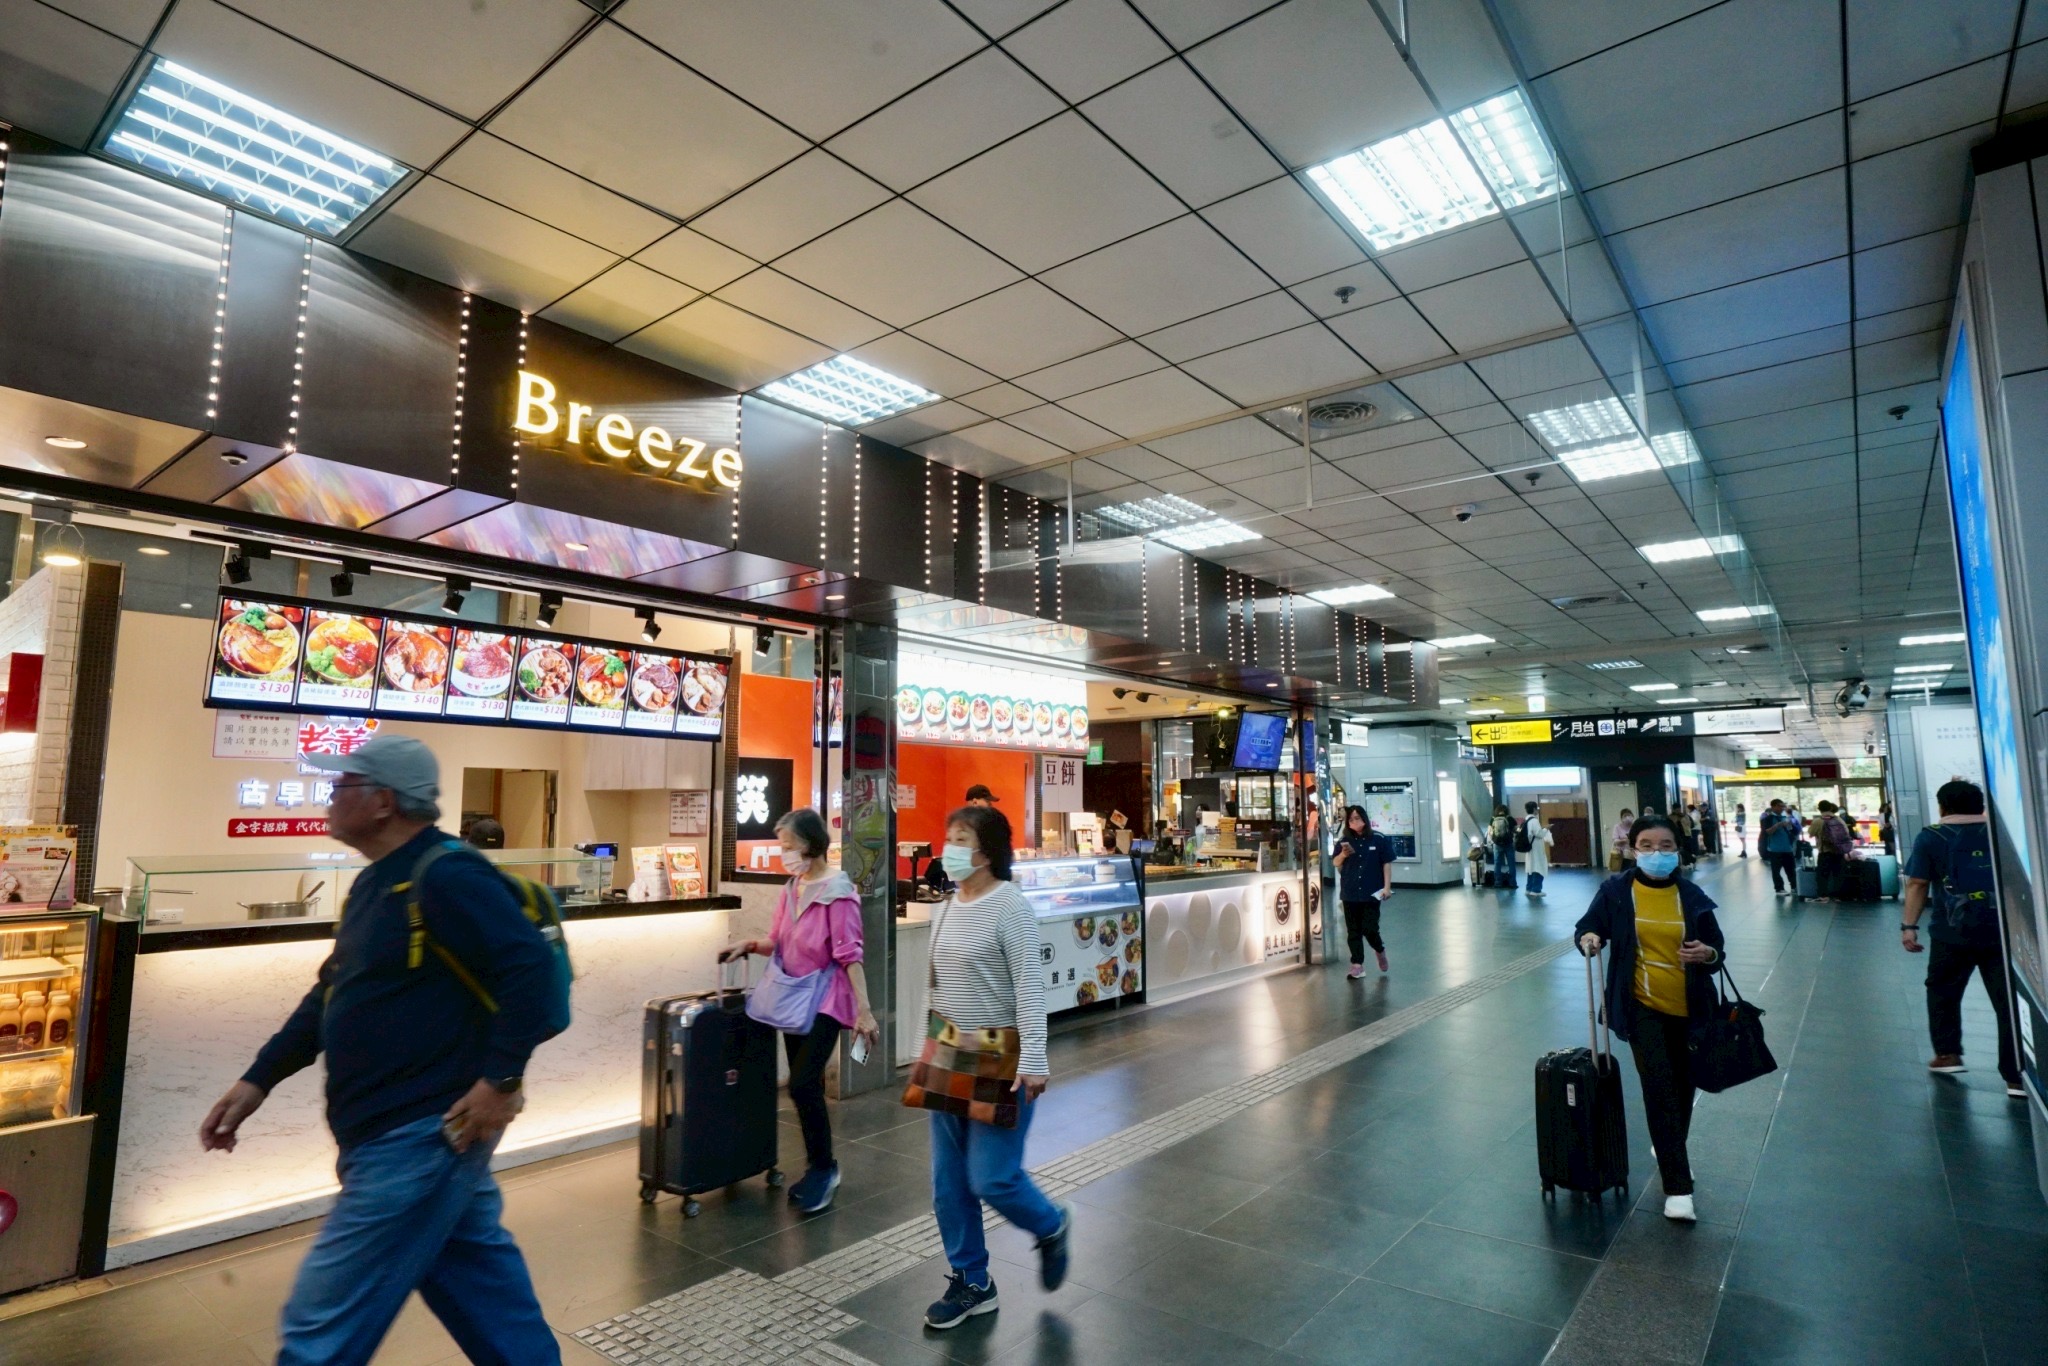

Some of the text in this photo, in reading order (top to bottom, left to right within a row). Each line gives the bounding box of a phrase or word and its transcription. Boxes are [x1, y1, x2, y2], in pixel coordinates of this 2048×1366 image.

[513, 369, 743, 488] Breeze
[259, 682, 290, 694] $130
[342, 688, 370, 699] $120
[413, 694, 439, 705] $140
[481, 701, 504, 710] $130
[544, 705, 566, 715] $120
[600, 711, 621, 720] $120
[1571, 721, 1594, 733] 月台
[1658, 716, 1682, 727] 高鐵
[1490, 726, 1507, 740] 出口
[1045, 760, 1076, 786] 豆餅
[234, 820, 289, 834] 金字招牌
